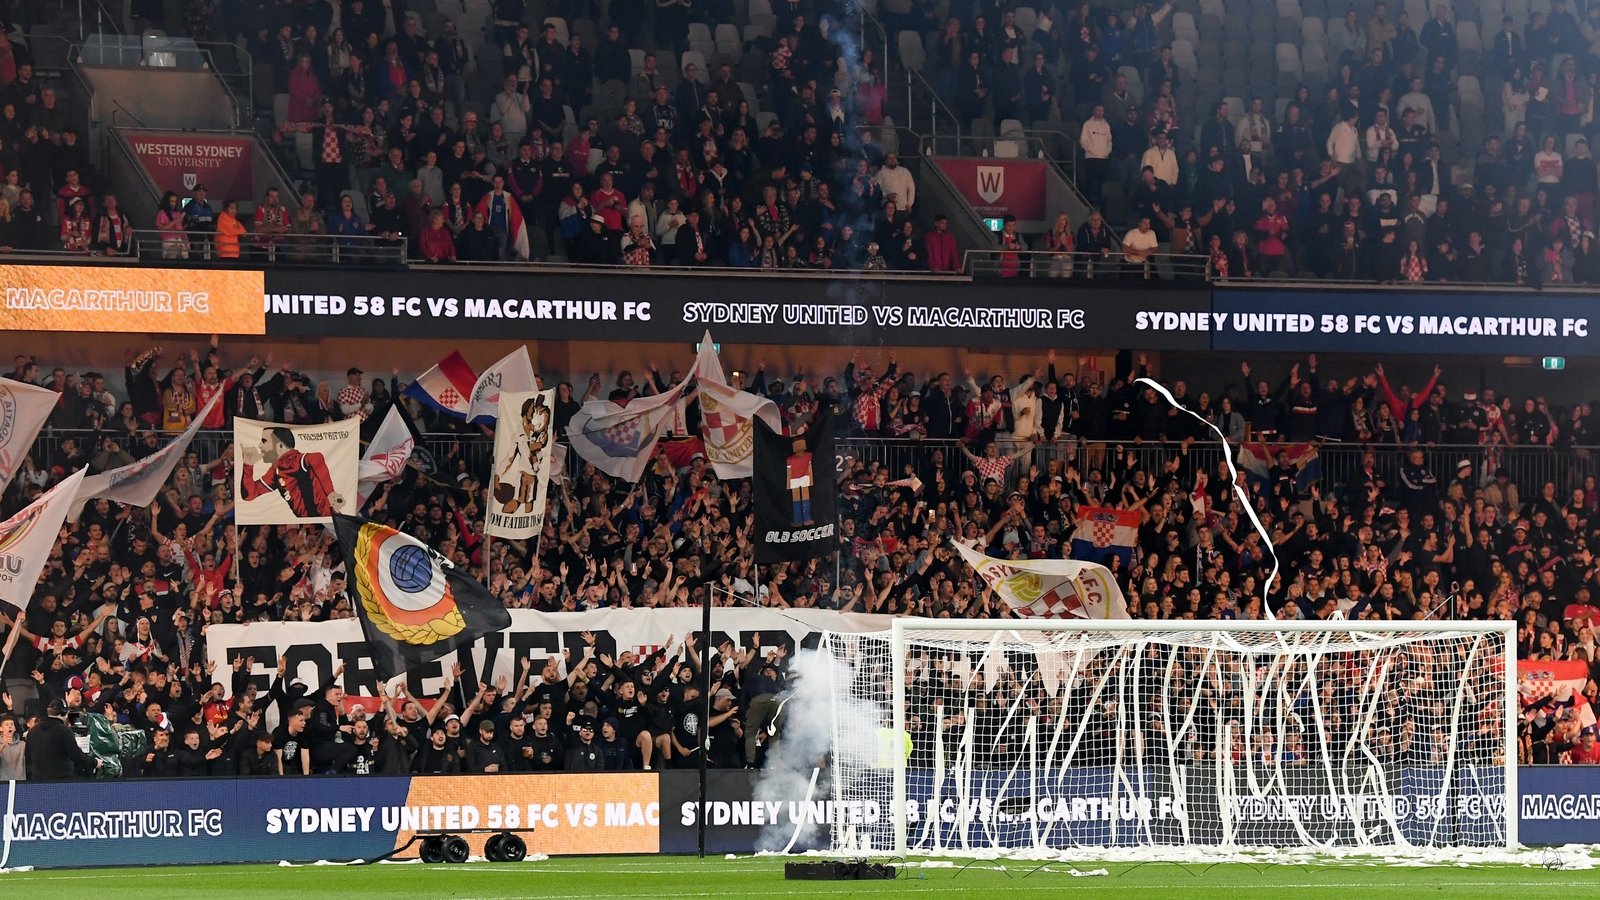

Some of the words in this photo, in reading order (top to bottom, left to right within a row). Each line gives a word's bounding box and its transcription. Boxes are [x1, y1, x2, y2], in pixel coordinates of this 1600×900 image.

[135, 143, 193, 156] WESTERN
[195, 145, 242, 158] SYDNEY
[158, 156, 221, 168] UNIVERSITY
[980, 172, 1001, 193] W
[6, 288, 172, 313] MACARTHUR
[177, 292, 209, 313] FC
[353, 296, 386, 316] 58
[392, 297, 422, 317] FC
[426, 298, 459, 318] VS
[464, 298, 617, 320] MACARTHUR
[624, 302, 651, 321] FC
[683, 302, 778, 324] SYDNEY
[782, 304, 868, 326] UNITED
[872, 306, 903, 327] VS
[907, 306, 1053, 329] MACARTHUR
[1056, 309, 1085, 329] FC
[1135, 311, 1228, 331] SYDNEY
[1233, 313, 1314, 333] UNITED
[1320, 314, 1349, 334] 58
[1354, 315, 1381, 334] FC
[1385, 315, 1414, 335] VS
[1418, 316, 1557, 337] MACARTHUR
[1562, 318, 1588, 337] FC
[503, 515, 530, 529] FATHER
[765, 531, 790, 543] OLD
[789, 523, 834, 543] SOCCER
[3, 810, 183, 842] MACARTHUR
[188, 809, 222, 837] FC
[266, 807, 375, 834] SYDNEY
[381, 805, 480, 832] UNITED
[487, 804, 520, 829] 58
[527, 803, 559, 828] FC
[565, 803, 598, 827] VS
[604, 802, 660, 826] MAC
[681, 801, 783, 826] SYDNEY
[789, 800, 881, 825] UNITED
